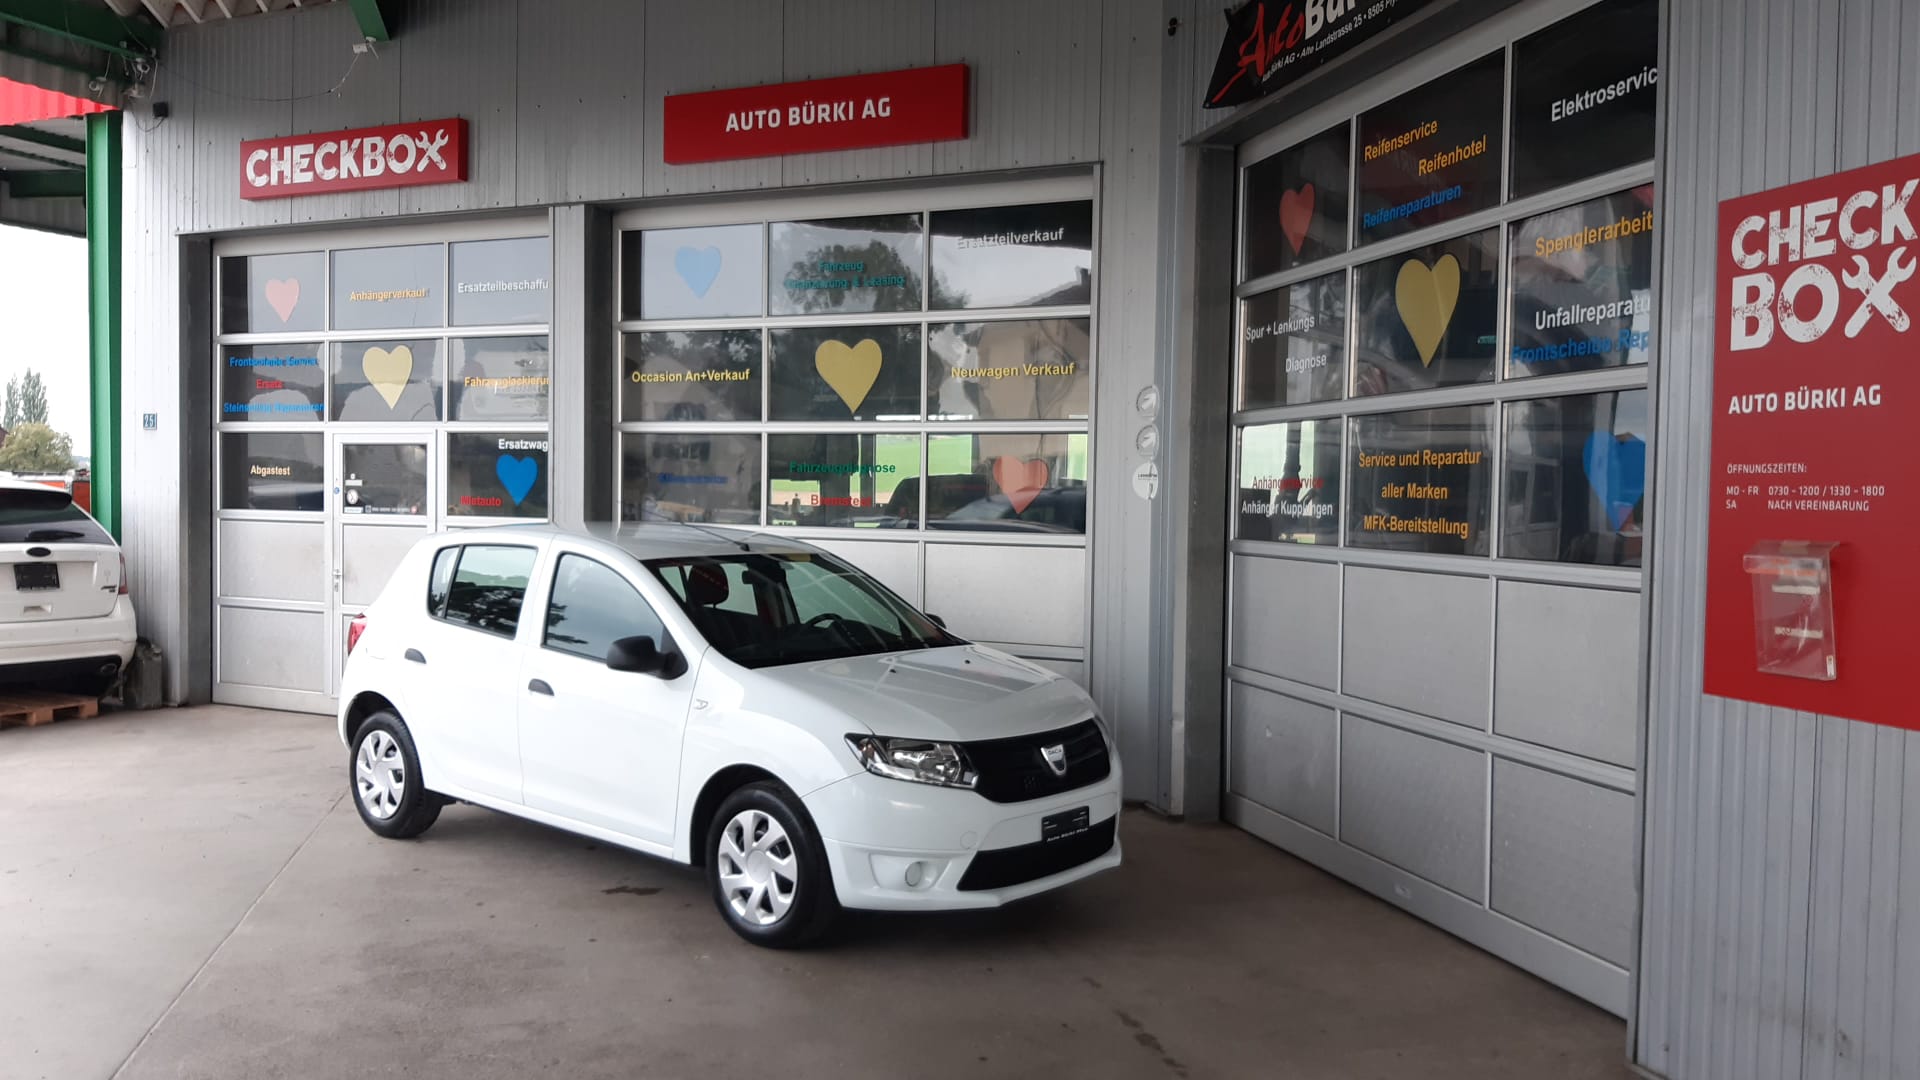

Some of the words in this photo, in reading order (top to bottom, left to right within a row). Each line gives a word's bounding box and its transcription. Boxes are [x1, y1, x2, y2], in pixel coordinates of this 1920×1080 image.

[1284, 52, 1296, 66] AG
[1300, 45, 1314, 59] Alte
[1315, 22, 1353, 51] Landstrasse
[1353, 14, 1363, 28] 25
[1367, 2, 1384, 19] 8505
[1551, 66, 1657, 122] Elektroservic
[725, 108, 781, 132] AUTO
[788, 100, 854, 126] BÜRKI
[861, 97, 891, 119] AG
[1364, 120, 1438, 162] Reifenservice
[246, 129, 448, 187] CHECKBOX
[1418, 134, 1487, 176] Reifenhotel
[1363, 184, 1462, 229] Reifenreparaturen
[1535, 211, 1653, 258] Spenglerarbeit
[1731, 178, 1919, 270] CHECK
[958, 227, 1064, 249] Ersatzteilverkauf
[818, 259, 864, 272] Fahrzeug
[1730, 246, 1917, 351] BOX
[1246, 326, 1265, 343] Spur
[1266, 325, 1272, 335] +
[1273, 316, 1315, 335] Lenkungs
[951, 366, 1018, 380] Neuwagen
[1023, 362, 1075, 376] Verkauf
[1285, 354, 1327, 373] Diagnose
[631, 370, 682, 383] Occasion
[684, 368, 750, 382] An+Verkauf
[1728, 393, 1778, 415] AUTO
[1784, 386, 1846, 411] BÜRKI
[1853, 384, 1881, 406] AG
[144, 414, 154, 427] 25
[498, 438, 548, 452] Ersatzwag
[789, 463, 896, 474] Fahrzeugdiagnose
[1359, 451, 1396, 468] Service
[1398, 450, 1420, 466] und
[1422, 448, 1482, 469] Reparatur
[1727, 463, 1807, 474] ÖFFNUNGSZEITEN:
[250, 464, 291, 477] Abgastest
[1381, 482, 1405, 498] aller
[1406, 483, 1448, 499] Marken
[1726, 485, 1740, 496] MO
[1747, 485, 1759, 496] FR
[1768, 485, 1789, 496] 0730
[1799, 485, 1820, 496] 1200
[1830, 485, 1851, 496] 1330
[1861, 485, 1885, 496] 1800
[1241, 500, 1280, 518] Anhänger
[1280, 500, 1333, 519] Kupplungen
[1726, 499, 1737, 509] SA
[1768, 500, 1792, 510] NACH
[1795, 500, 1869, 511] VEREINBARUNG
[1364, 515, 1469, 539] MFK-Bereitstellung
